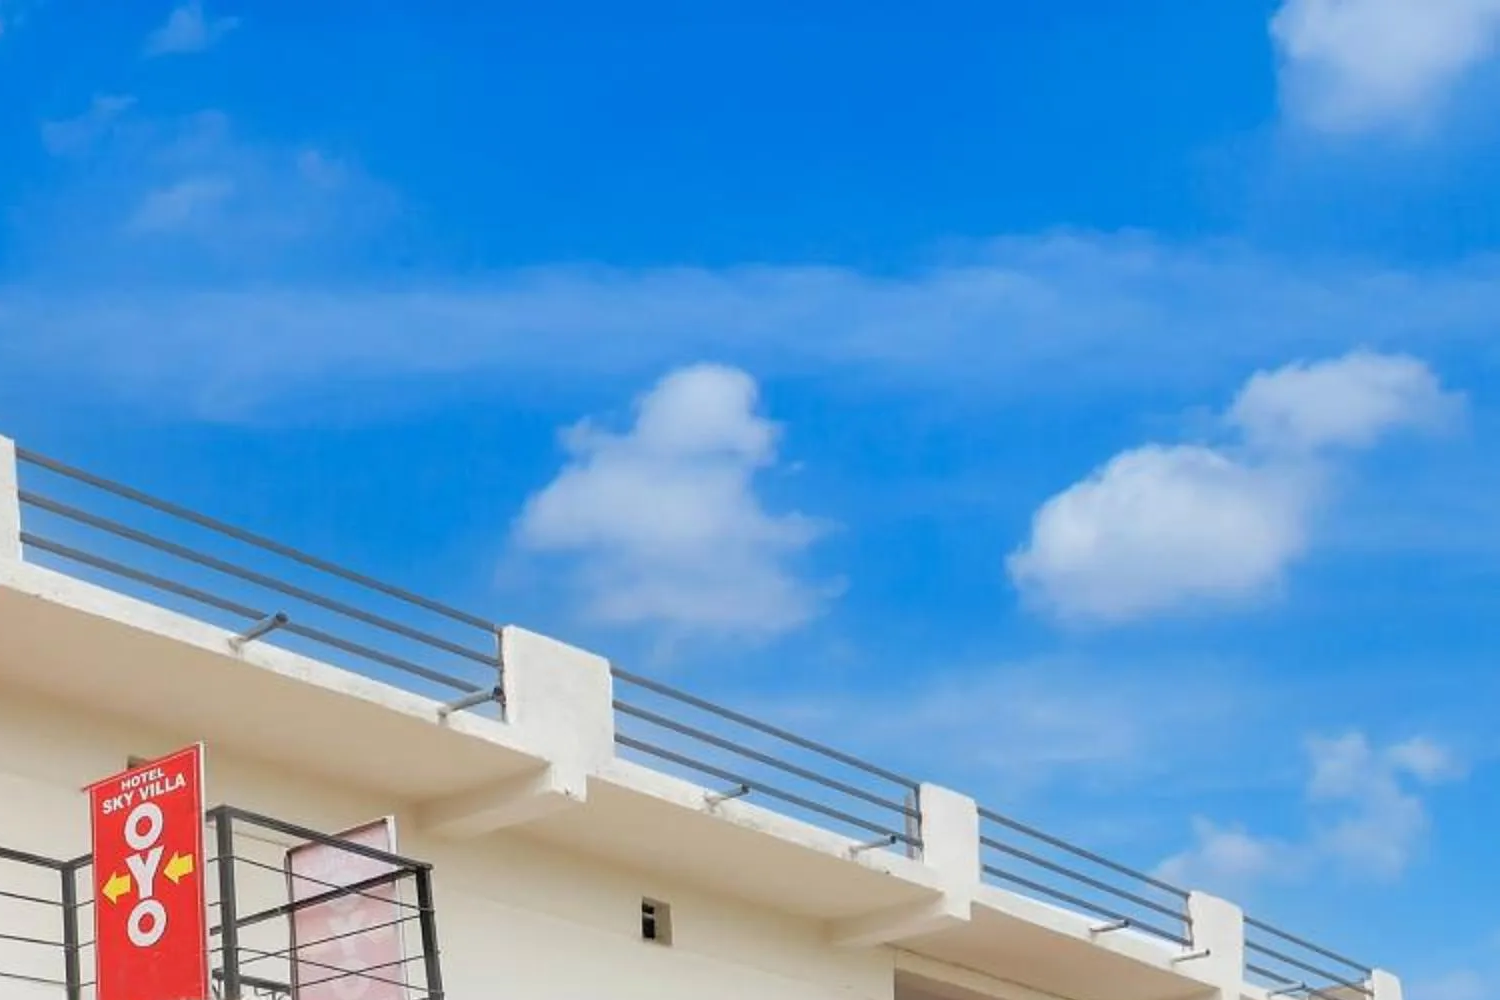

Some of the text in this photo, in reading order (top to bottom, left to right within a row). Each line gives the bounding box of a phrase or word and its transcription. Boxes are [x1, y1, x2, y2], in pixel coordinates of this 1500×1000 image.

[102, 772, 187, 815] SKY VILLA
[121, 767, 165, 791] HOTEL
[124, 801, 167, 947] OYO
